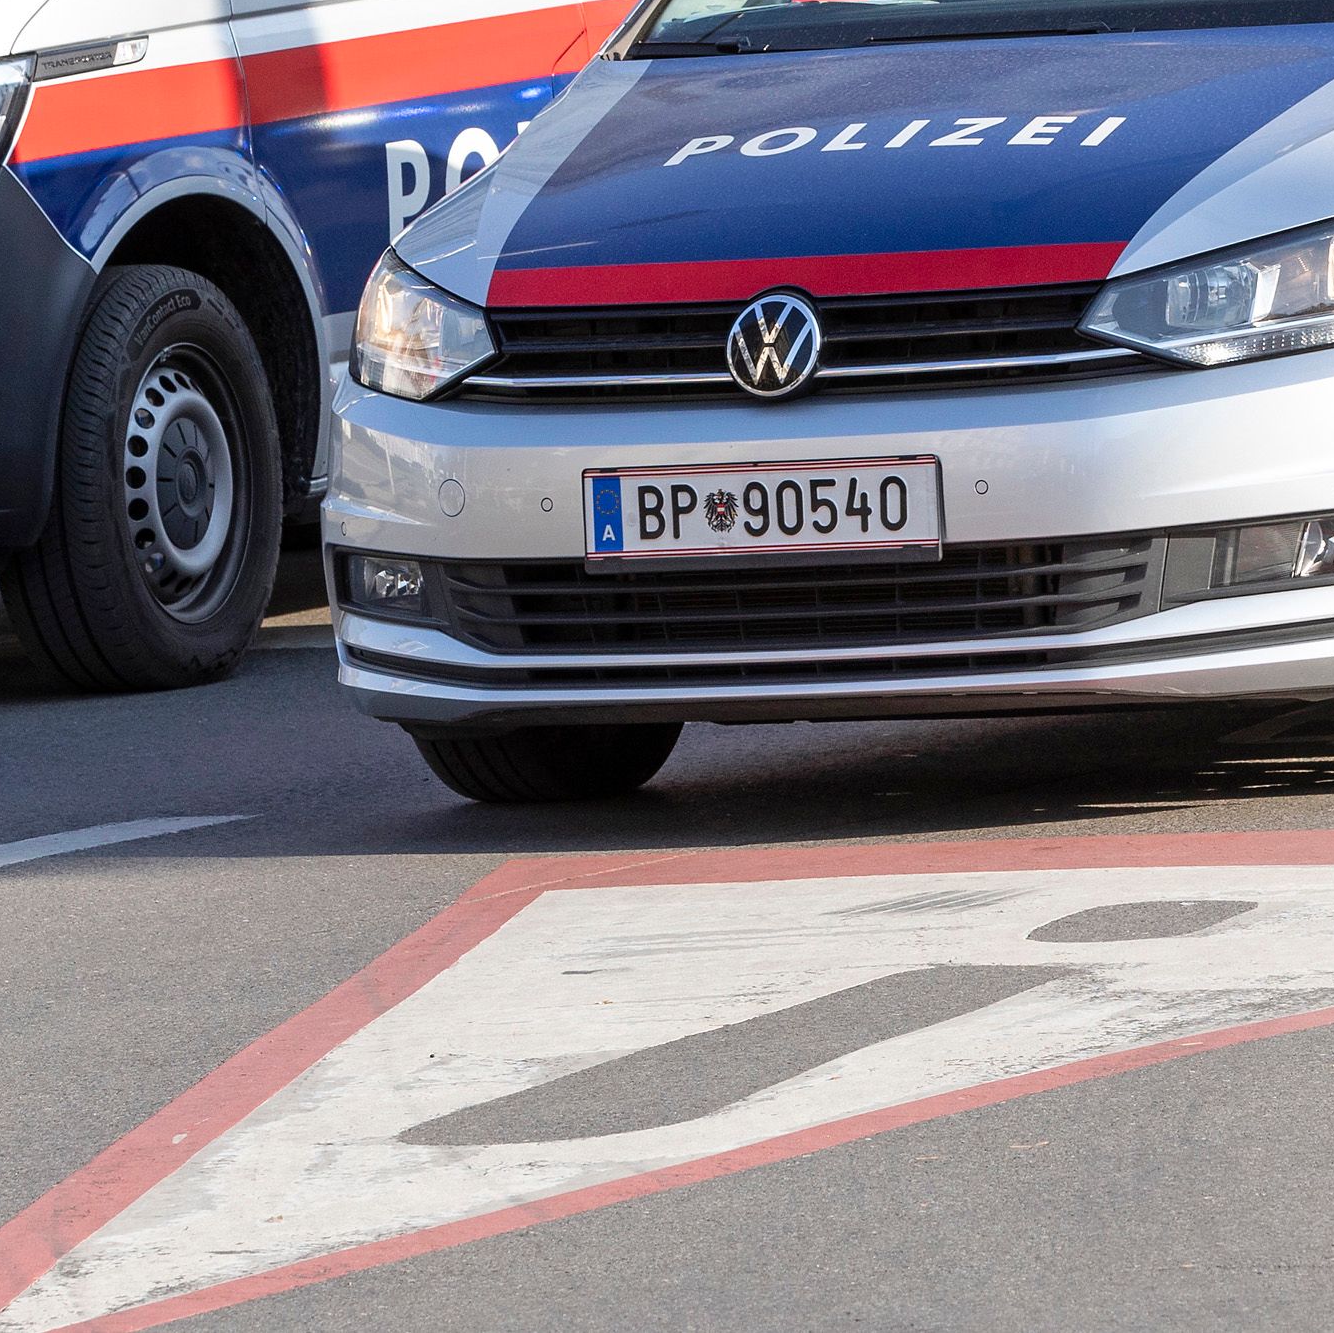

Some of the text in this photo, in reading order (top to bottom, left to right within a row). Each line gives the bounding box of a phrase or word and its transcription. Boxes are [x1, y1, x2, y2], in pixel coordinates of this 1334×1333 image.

[663, 116, 1127, 167] POLIZEI
[385, 121, 531, 246] PO
[175, 295, 192, 308] Eco
[728, 295, 819, 395] VW
[601, 524, 616, 542] A
[637, 475, 908, 540] BP 90540
